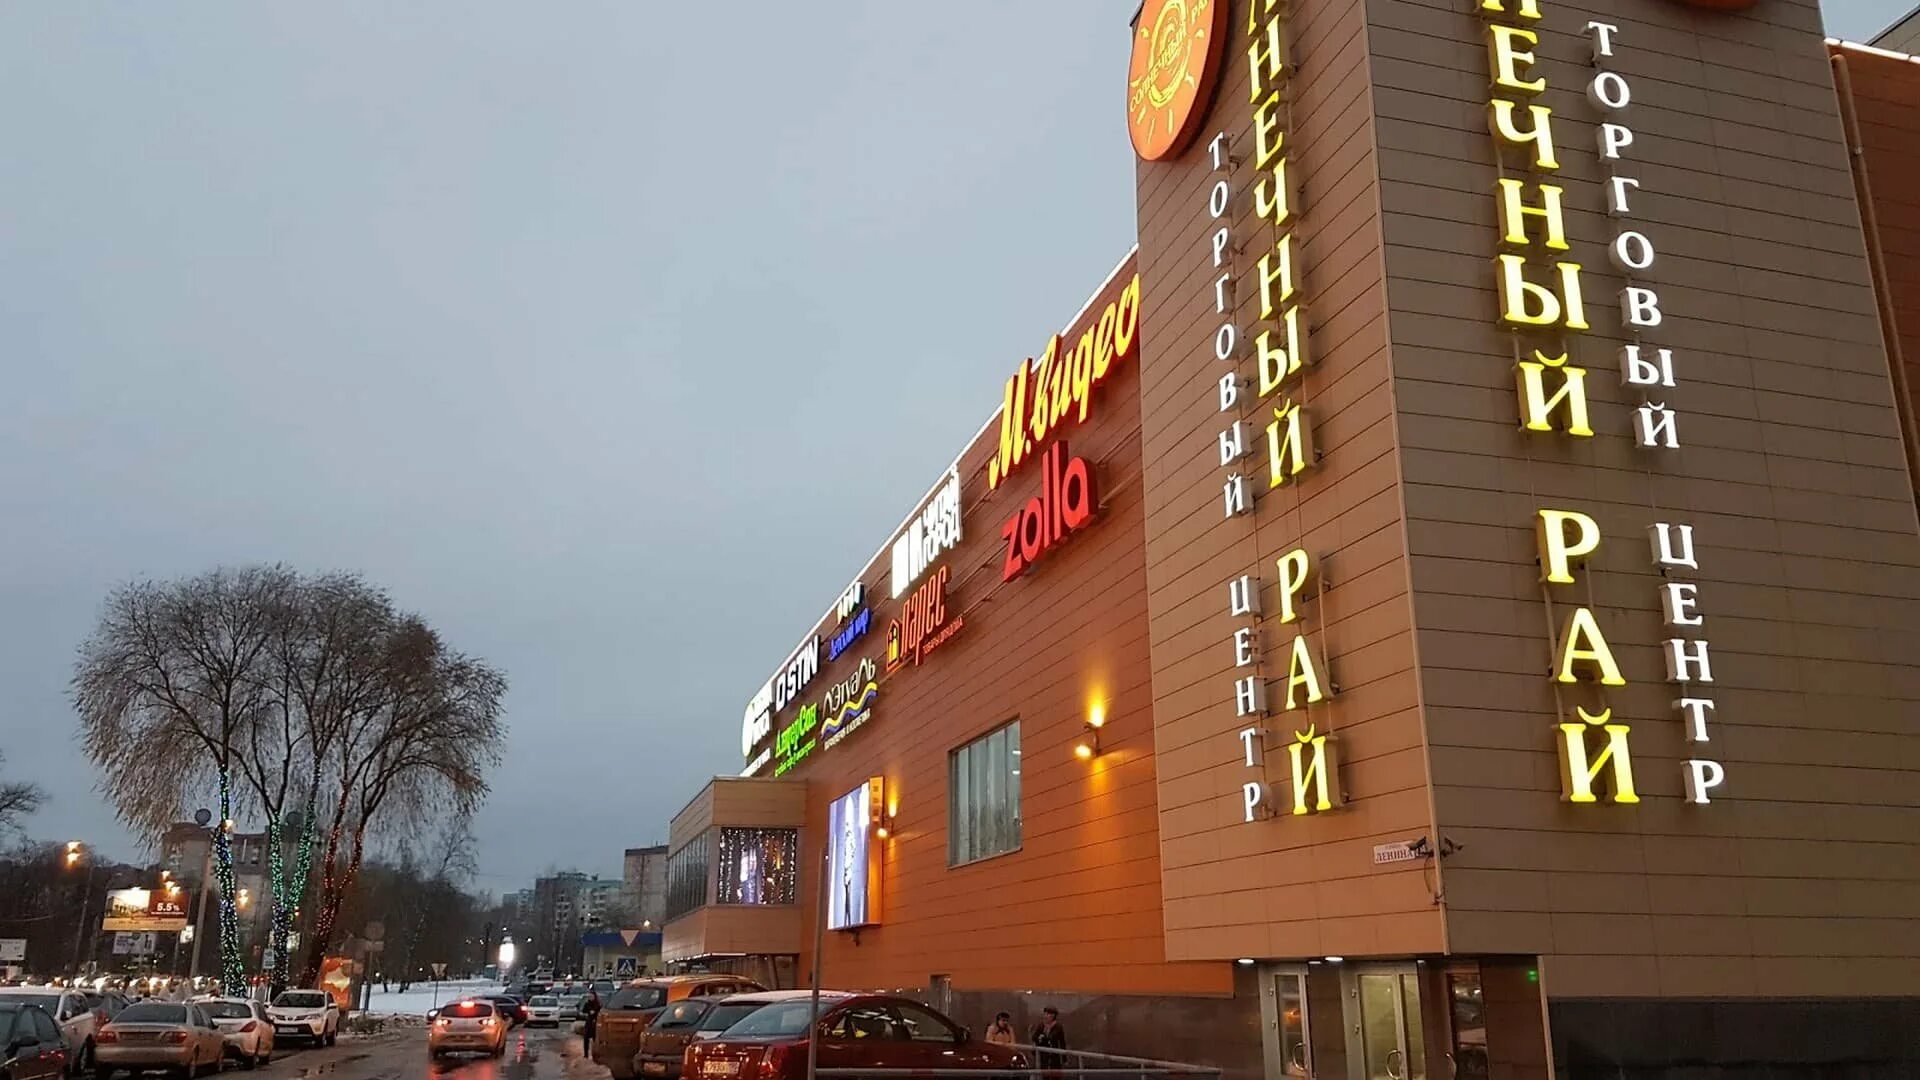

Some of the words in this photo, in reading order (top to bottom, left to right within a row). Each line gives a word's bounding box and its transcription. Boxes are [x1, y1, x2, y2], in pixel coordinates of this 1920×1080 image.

[1002, 440, 1090, 582] zolla
[1208, 132, 1246, 518] ТОРГОВЫЙ
[1229, 575, 1263, 822] ЦЕНТР
[1588, 20, 1680, 449] ТОРГОВЫЙ
[1655, 523, 1725, 804] ЦЕНТР
[1276, 549, 1331, 815] РАЙ
[1538, 509, 1640, 803] РАЙ
